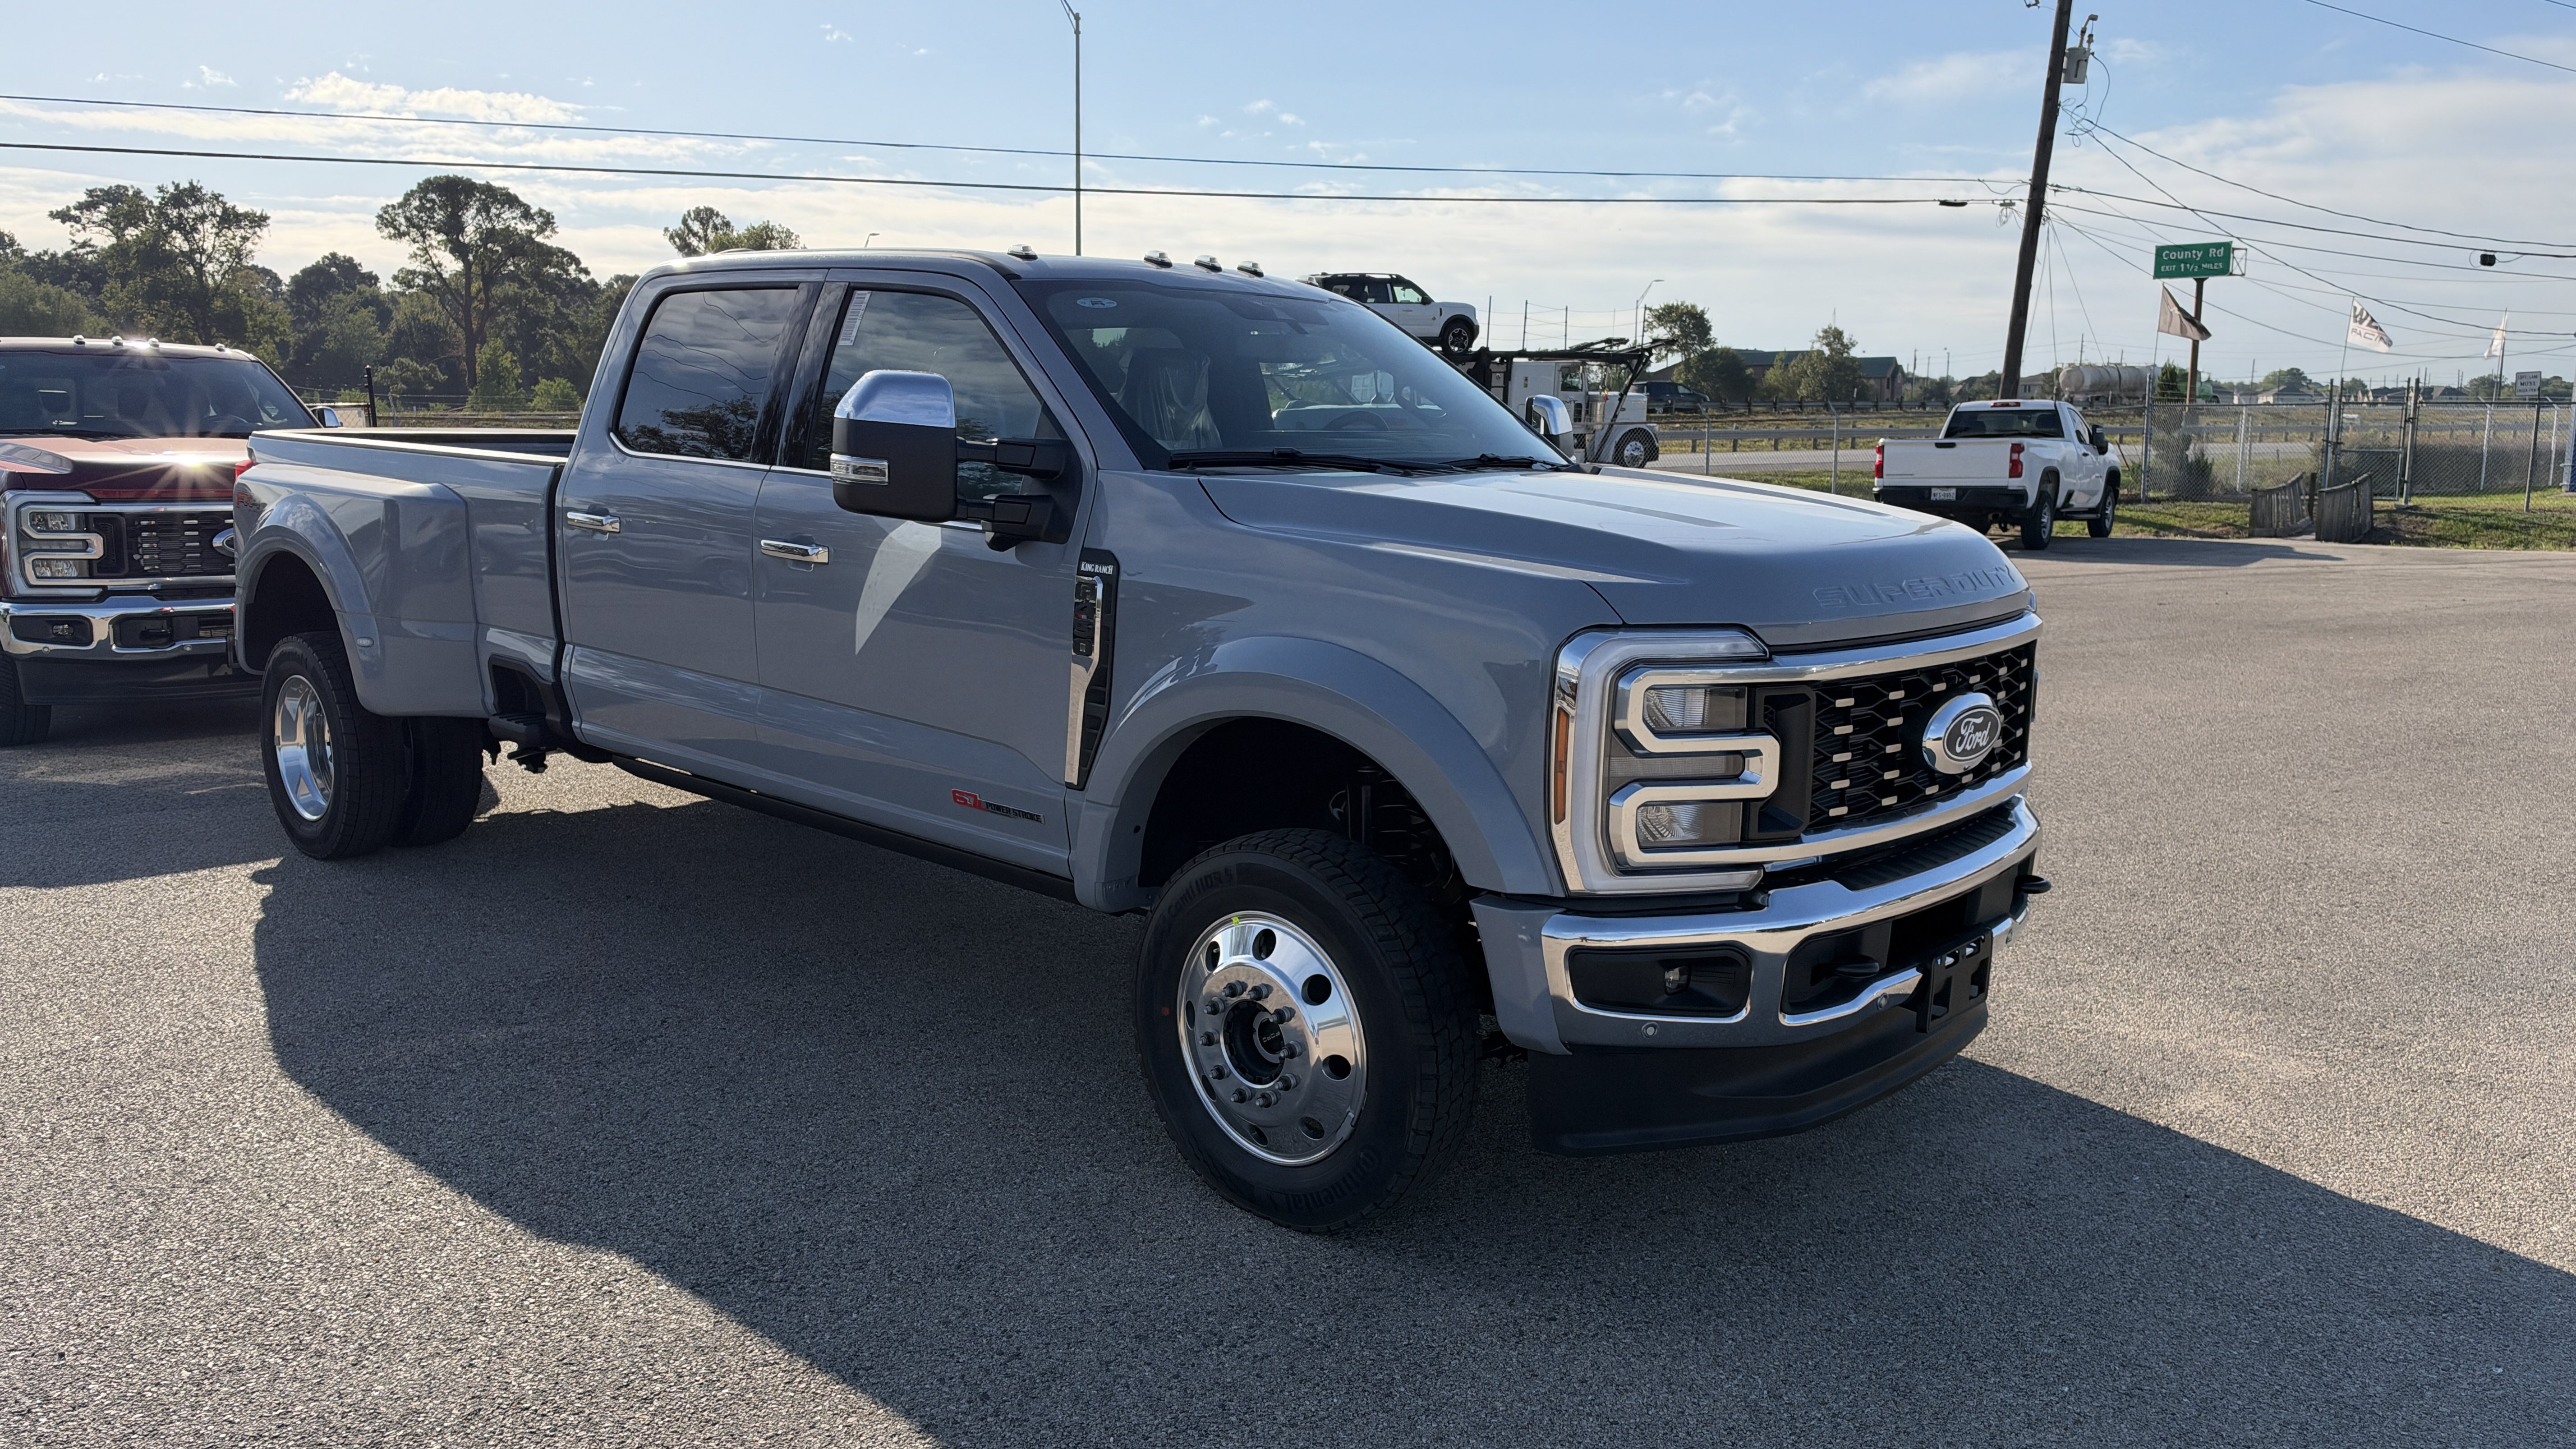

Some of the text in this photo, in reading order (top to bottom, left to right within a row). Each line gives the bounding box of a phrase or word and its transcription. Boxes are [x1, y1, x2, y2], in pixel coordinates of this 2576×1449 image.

[2162, 247, 2224, 261] County Rd
[1081, 561, 1113, 575] KING RANCH
[1812, 565, 2016, 609] SUPER DUTY
[1955, 716, 1992, 753] Ford
[985, 802, 1042, 823] POWER STROKE
